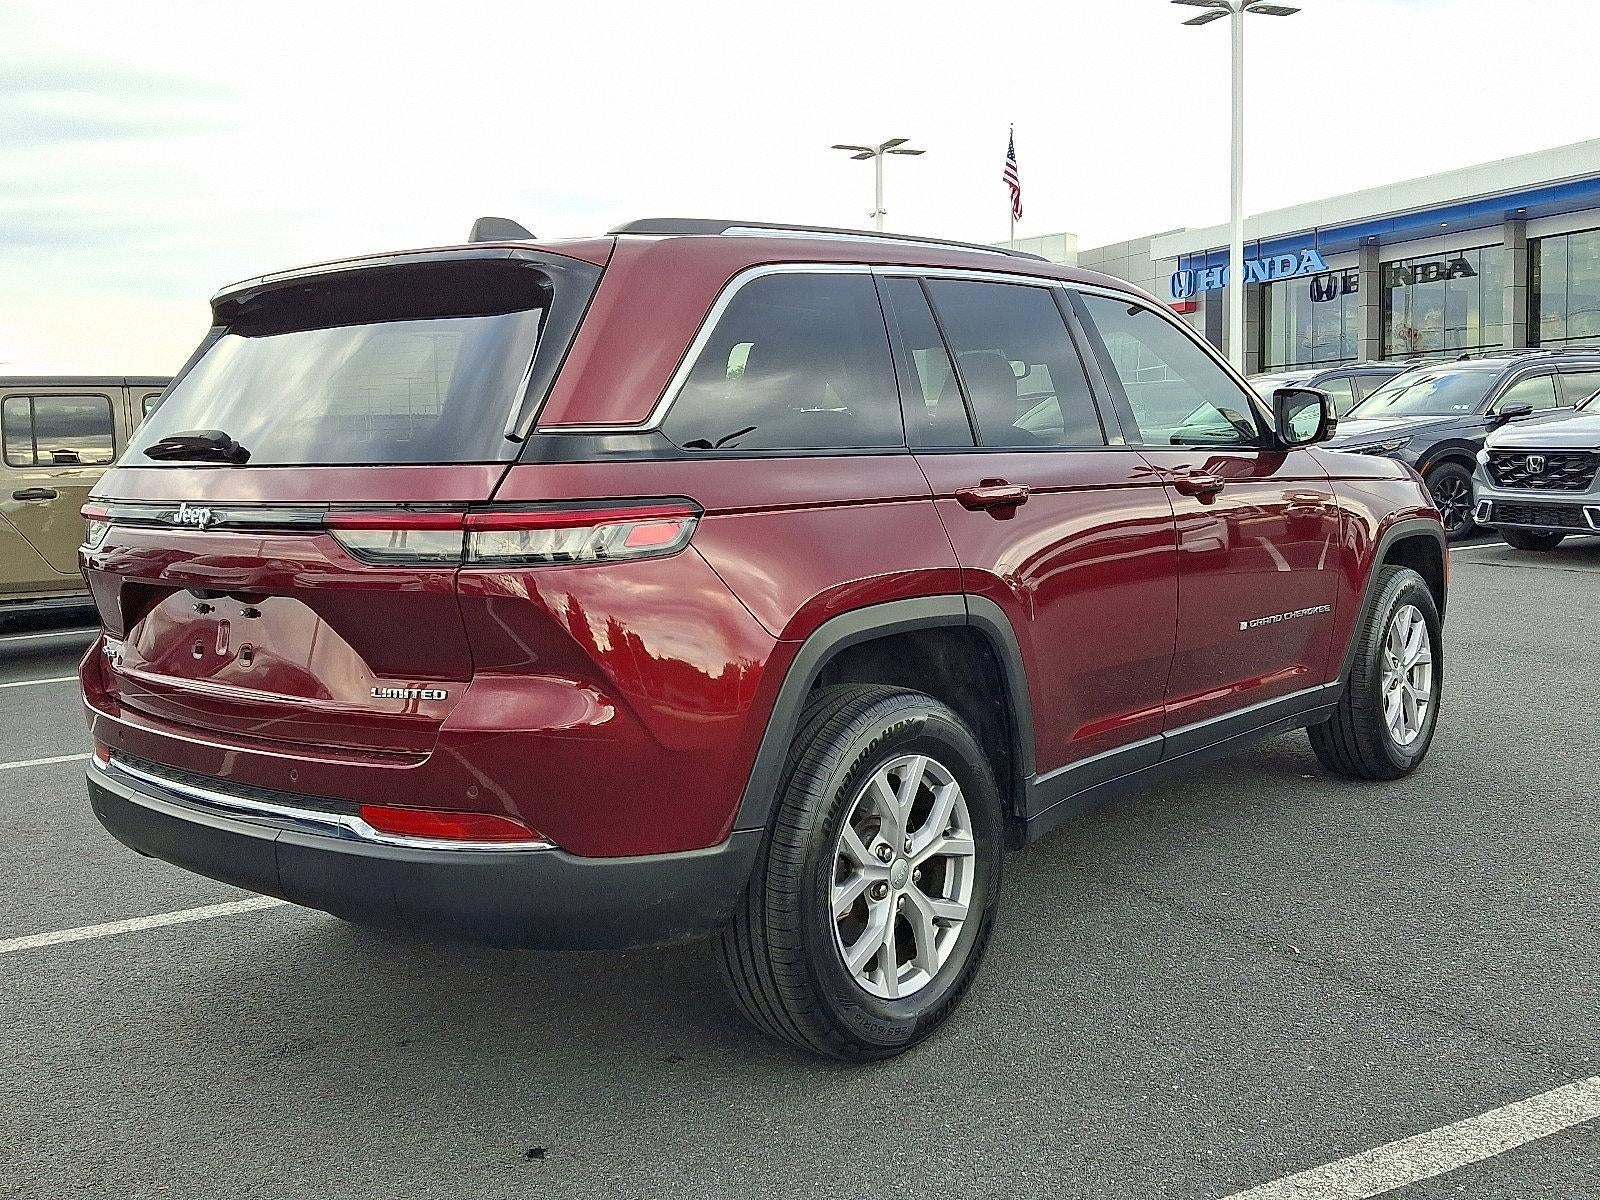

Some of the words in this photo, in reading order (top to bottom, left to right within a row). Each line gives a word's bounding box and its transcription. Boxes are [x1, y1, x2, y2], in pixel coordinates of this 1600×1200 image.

[1340, 257, 1478, 295] HNDA
[173, 502, 211, 529] Jeep
[1249, 614, 1282, 628] GRAND
[1283, 604, 1331, 620] CHEROKEE
[370, 687, 448, 700] LIMITED
